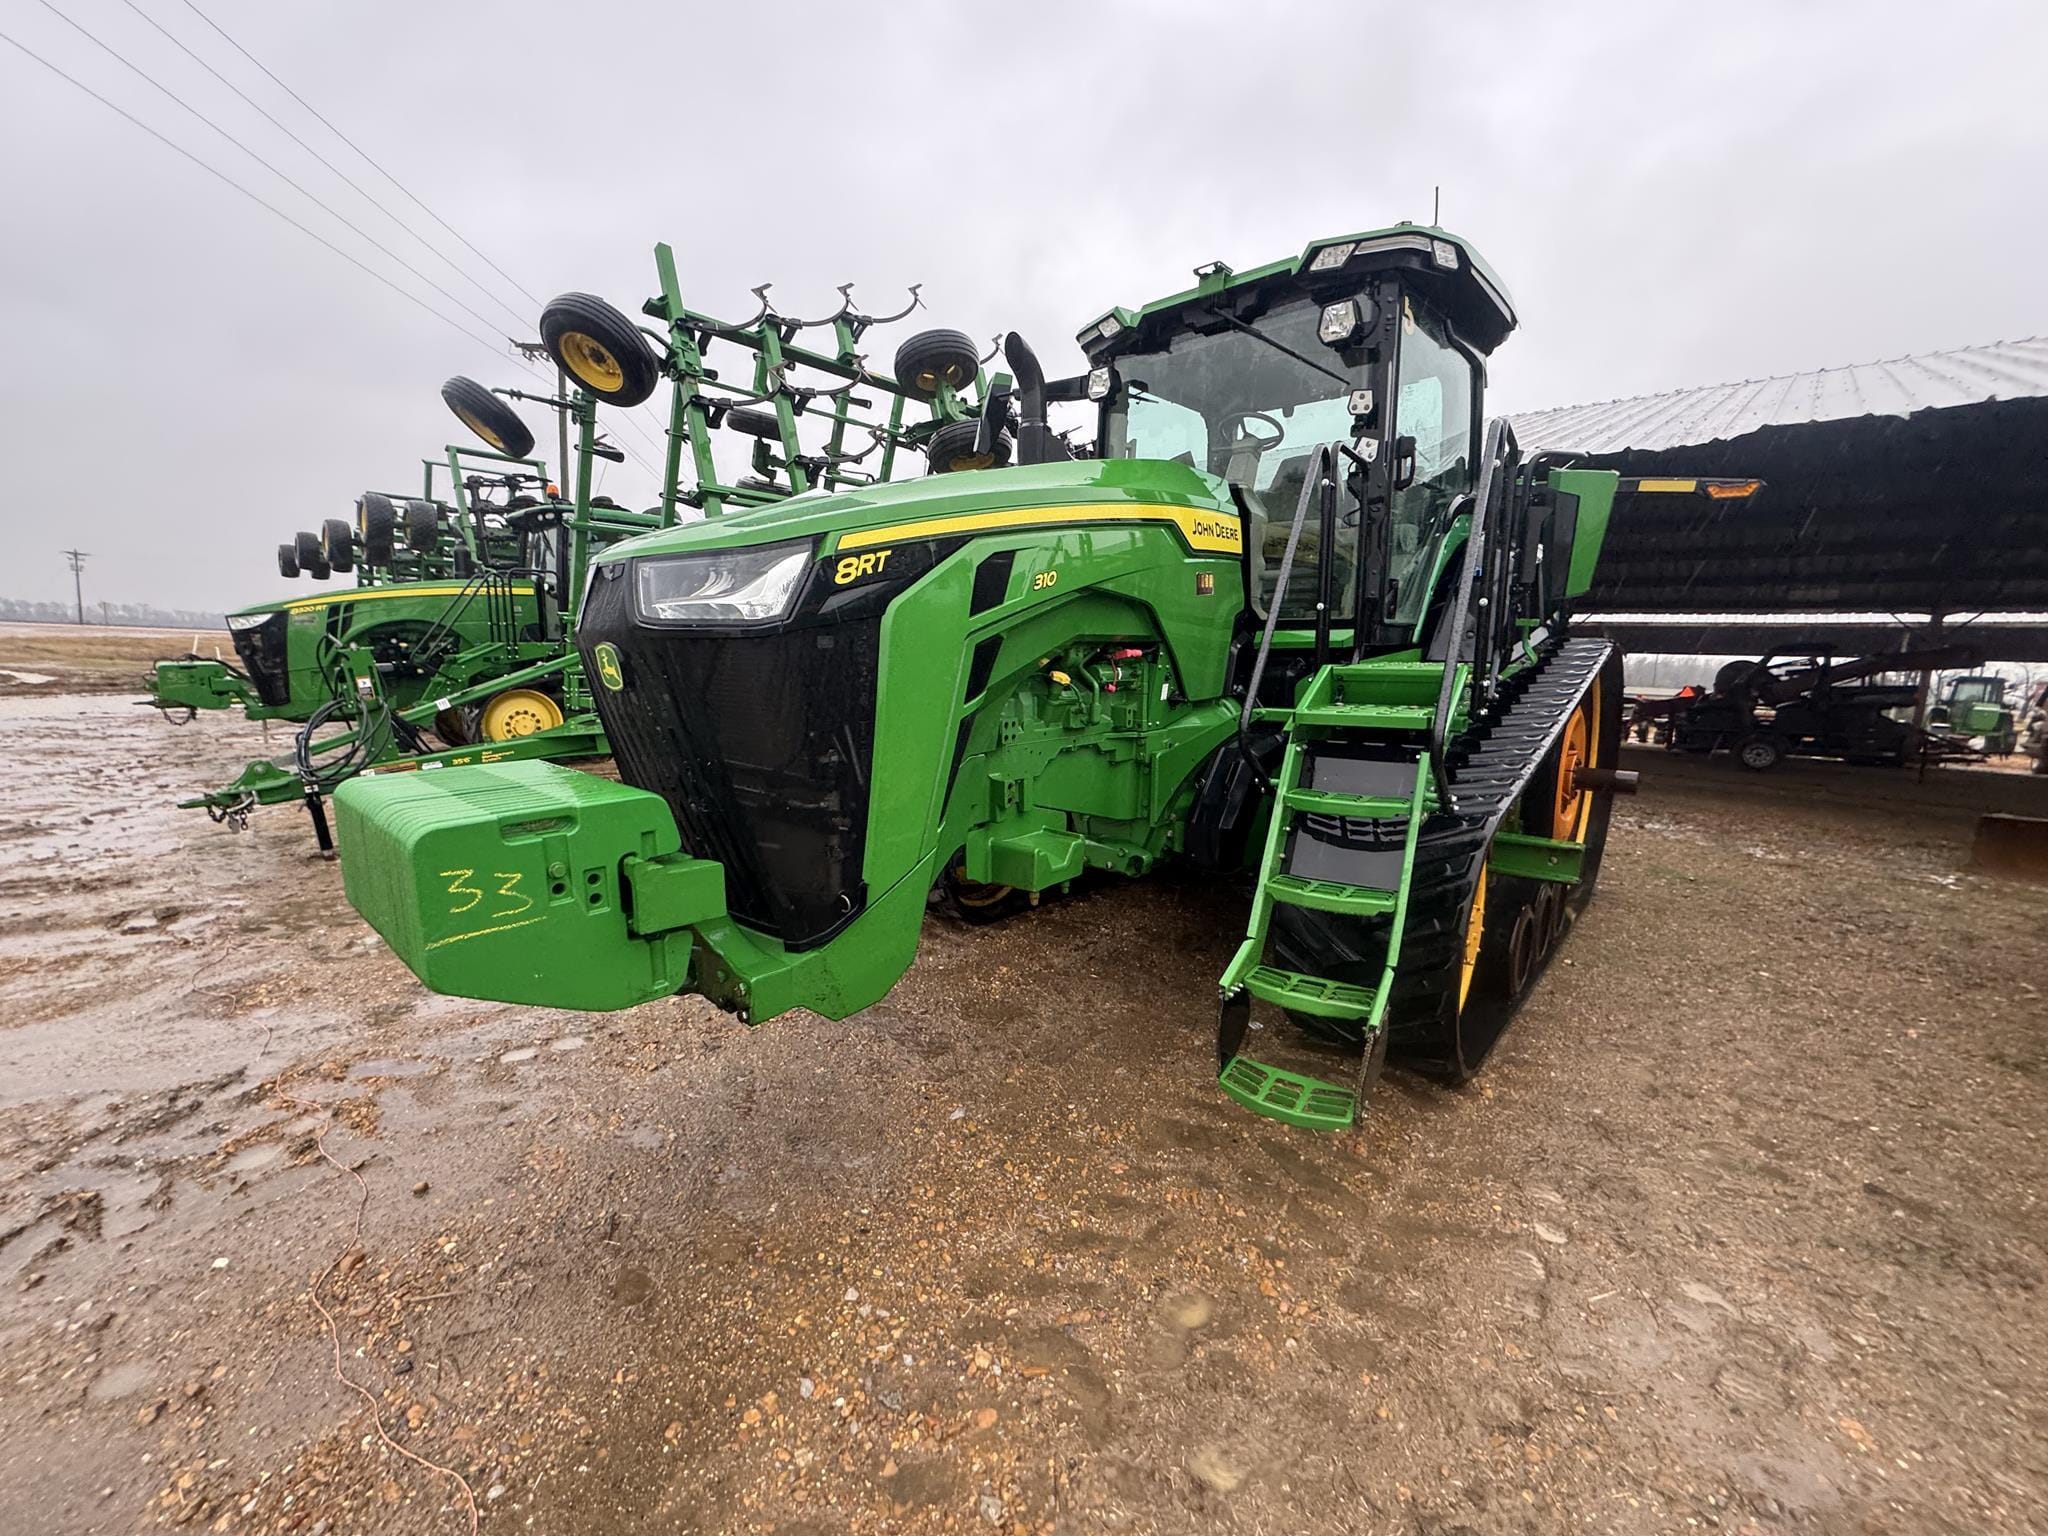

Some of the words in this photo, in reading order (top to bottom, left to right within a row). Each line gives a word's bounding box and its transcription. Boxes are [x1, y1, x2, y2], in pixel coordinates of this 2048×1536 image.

[1192, 518, 1214, 537] JOHN
[1215, 522, 1239, 541] DEERE
[833, 549, 892, 586] 8RT
[1032, 570, 1058, 591] 310
[439, 868, 534, 918] 33
